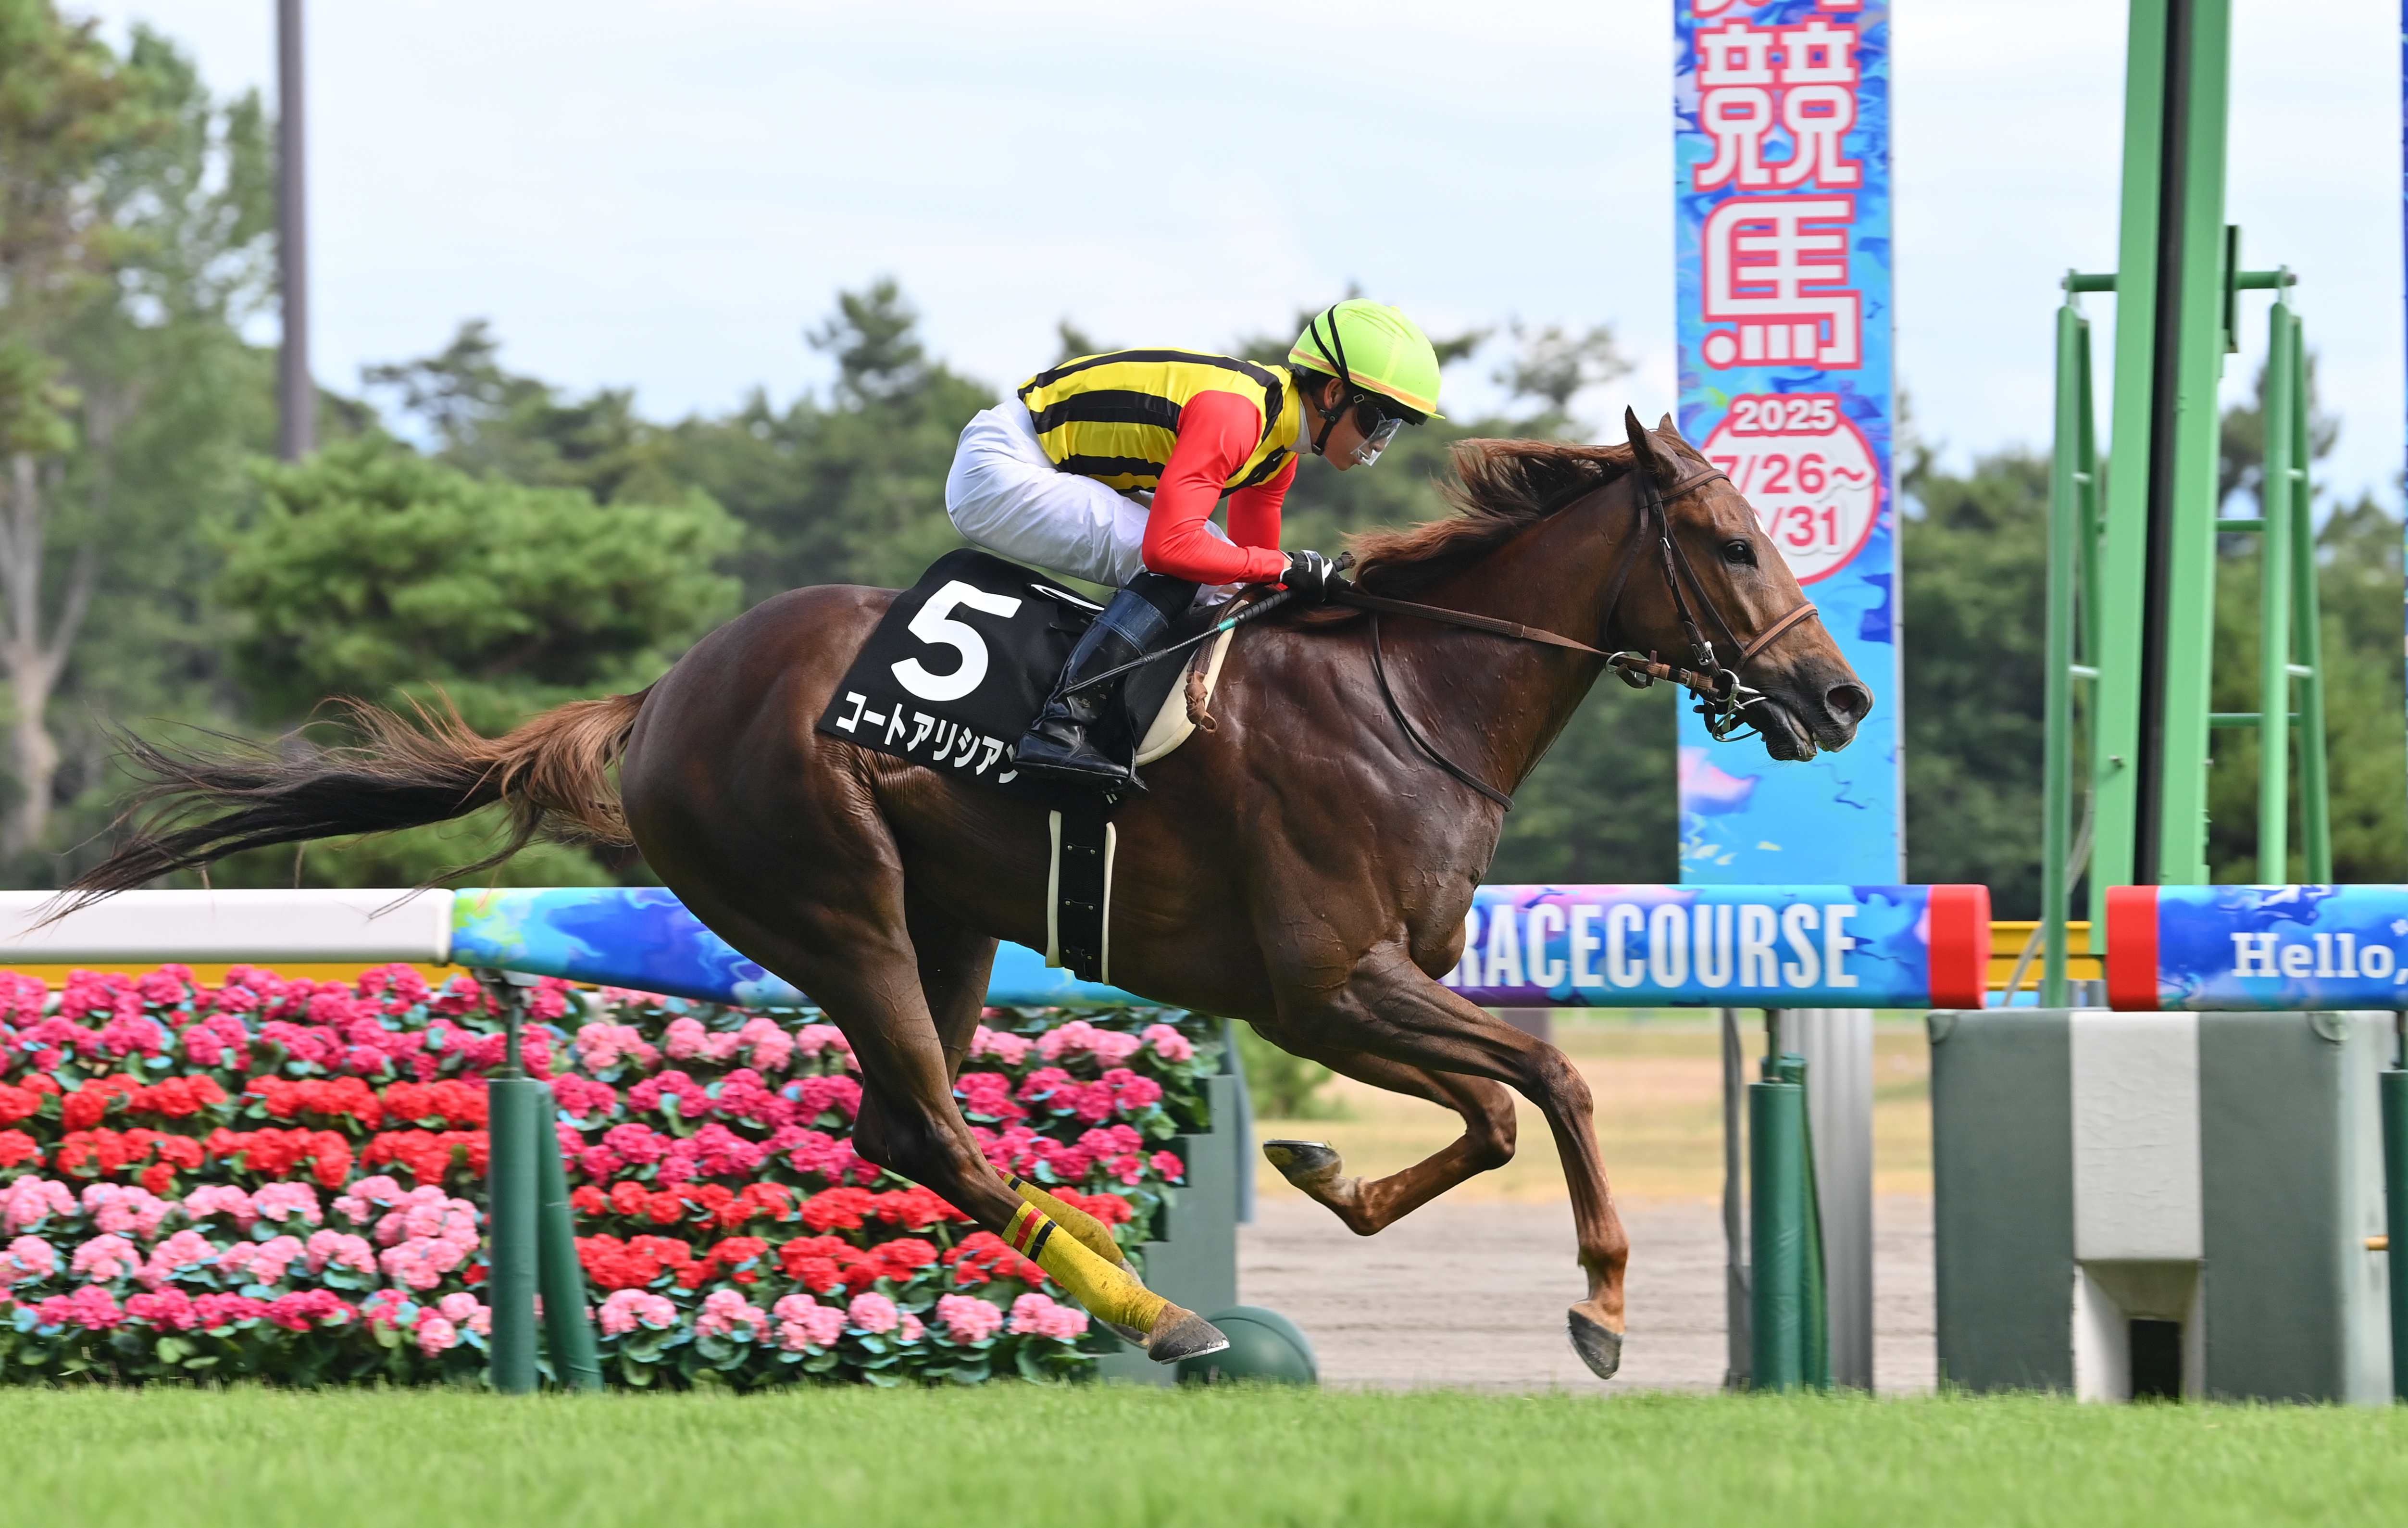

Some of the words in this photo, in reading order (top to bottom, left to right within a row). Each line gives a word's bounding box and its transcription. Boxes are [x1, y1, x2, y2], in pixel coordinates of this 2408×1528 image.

[1695, 0, 1861, 368] 競馬
[1733, 400, 1837, 431] 2025
[1754, 506, 1836, 547] /31
[891, 579, 1023, 701] 5
[1442, 903, 1858, 988] RACECOURSE
[2229, 932, 2408, 985] Hello,
